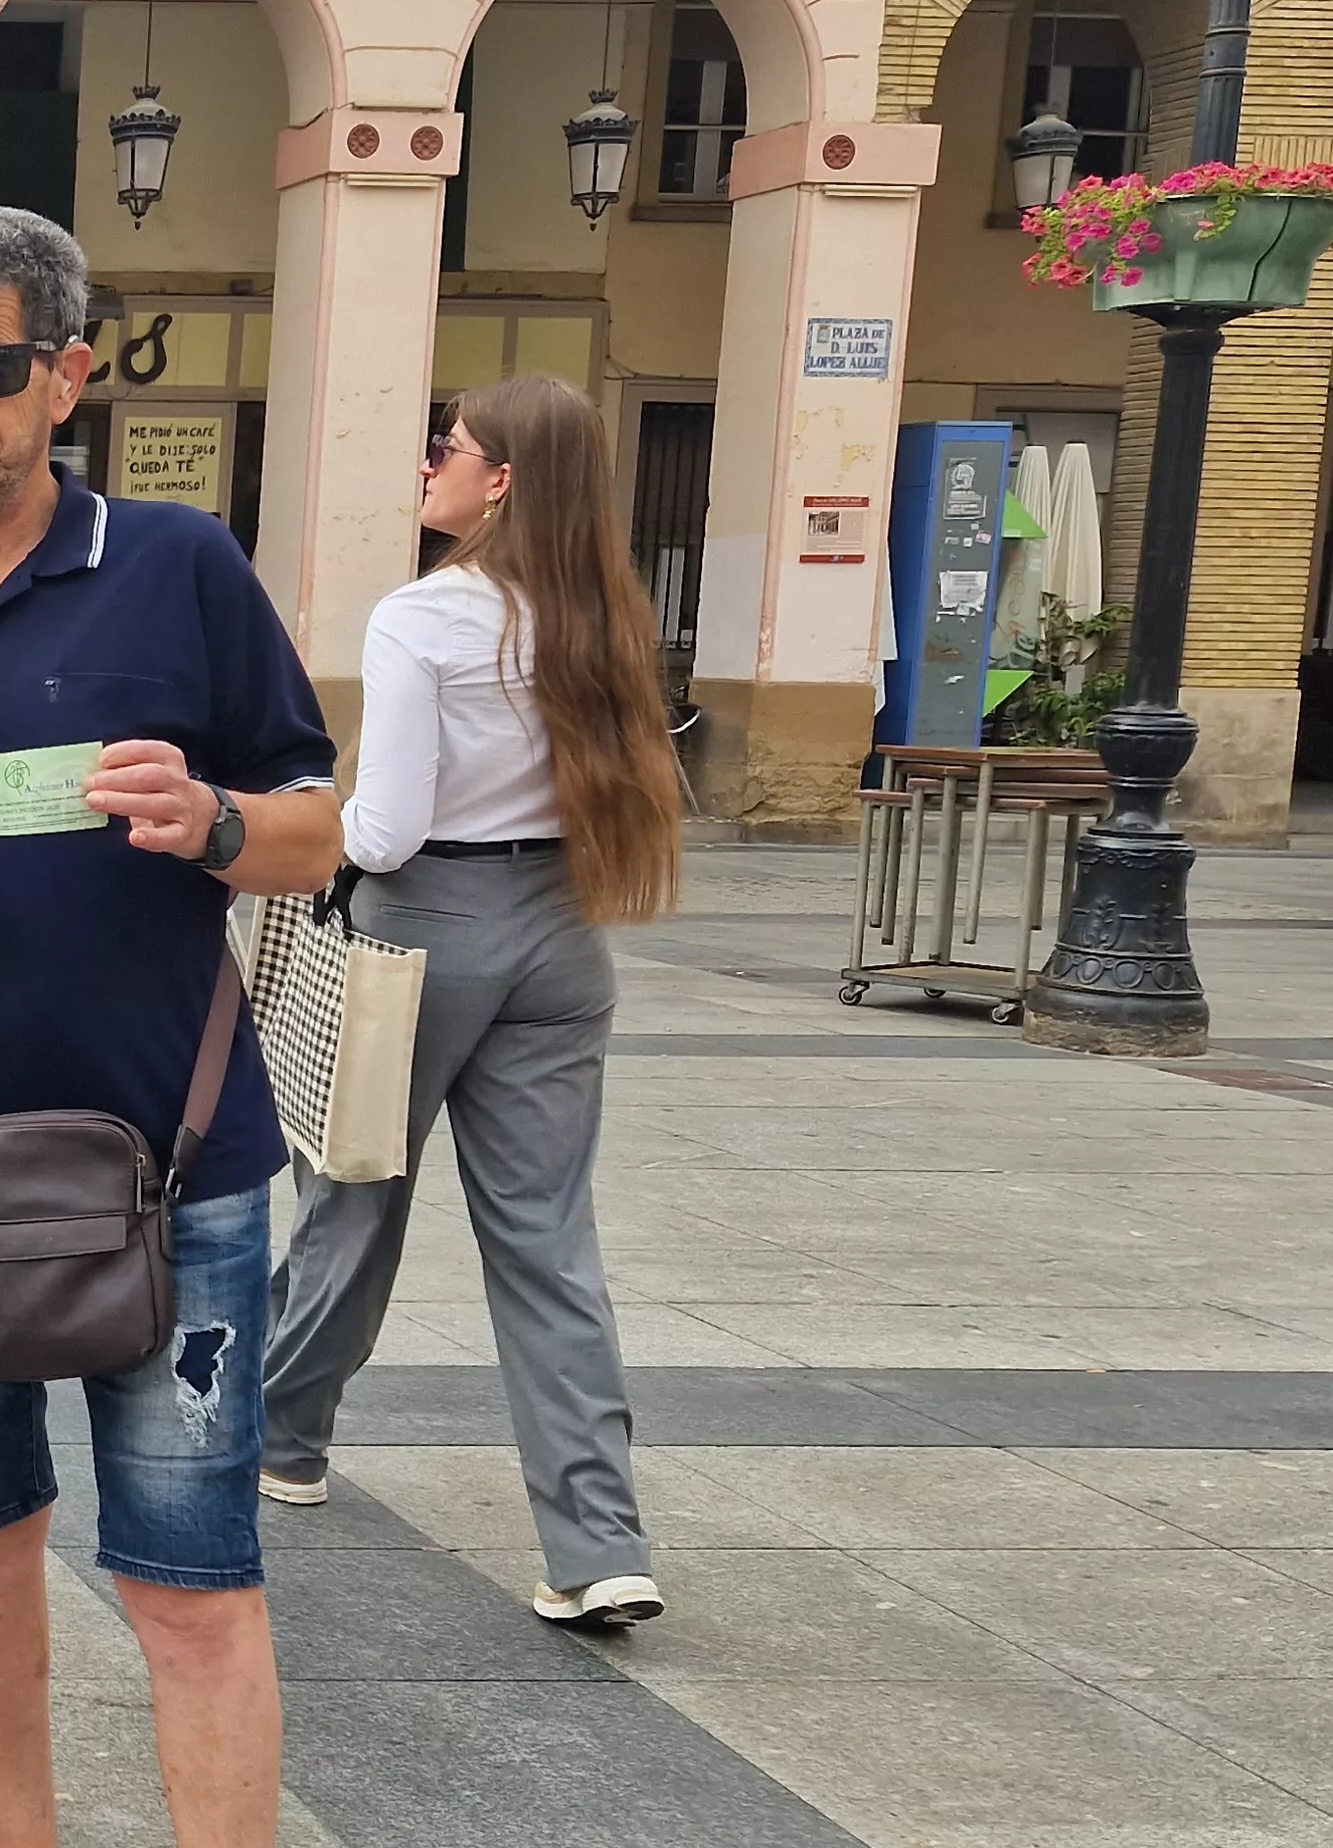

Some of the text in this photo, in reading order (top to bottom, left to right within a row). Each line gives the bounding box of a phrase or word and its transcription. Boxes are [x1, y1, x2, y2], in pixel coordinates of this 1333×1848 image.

[832, 327, 885, 339] PLAZA DE
[846, 342, 879, 354] LUIS
[129, 423, 216, 439] ME PIDIÓ UN CAFÉ
[130, 444, 137, 456] Y
[143, 444, 153, 455] LE
